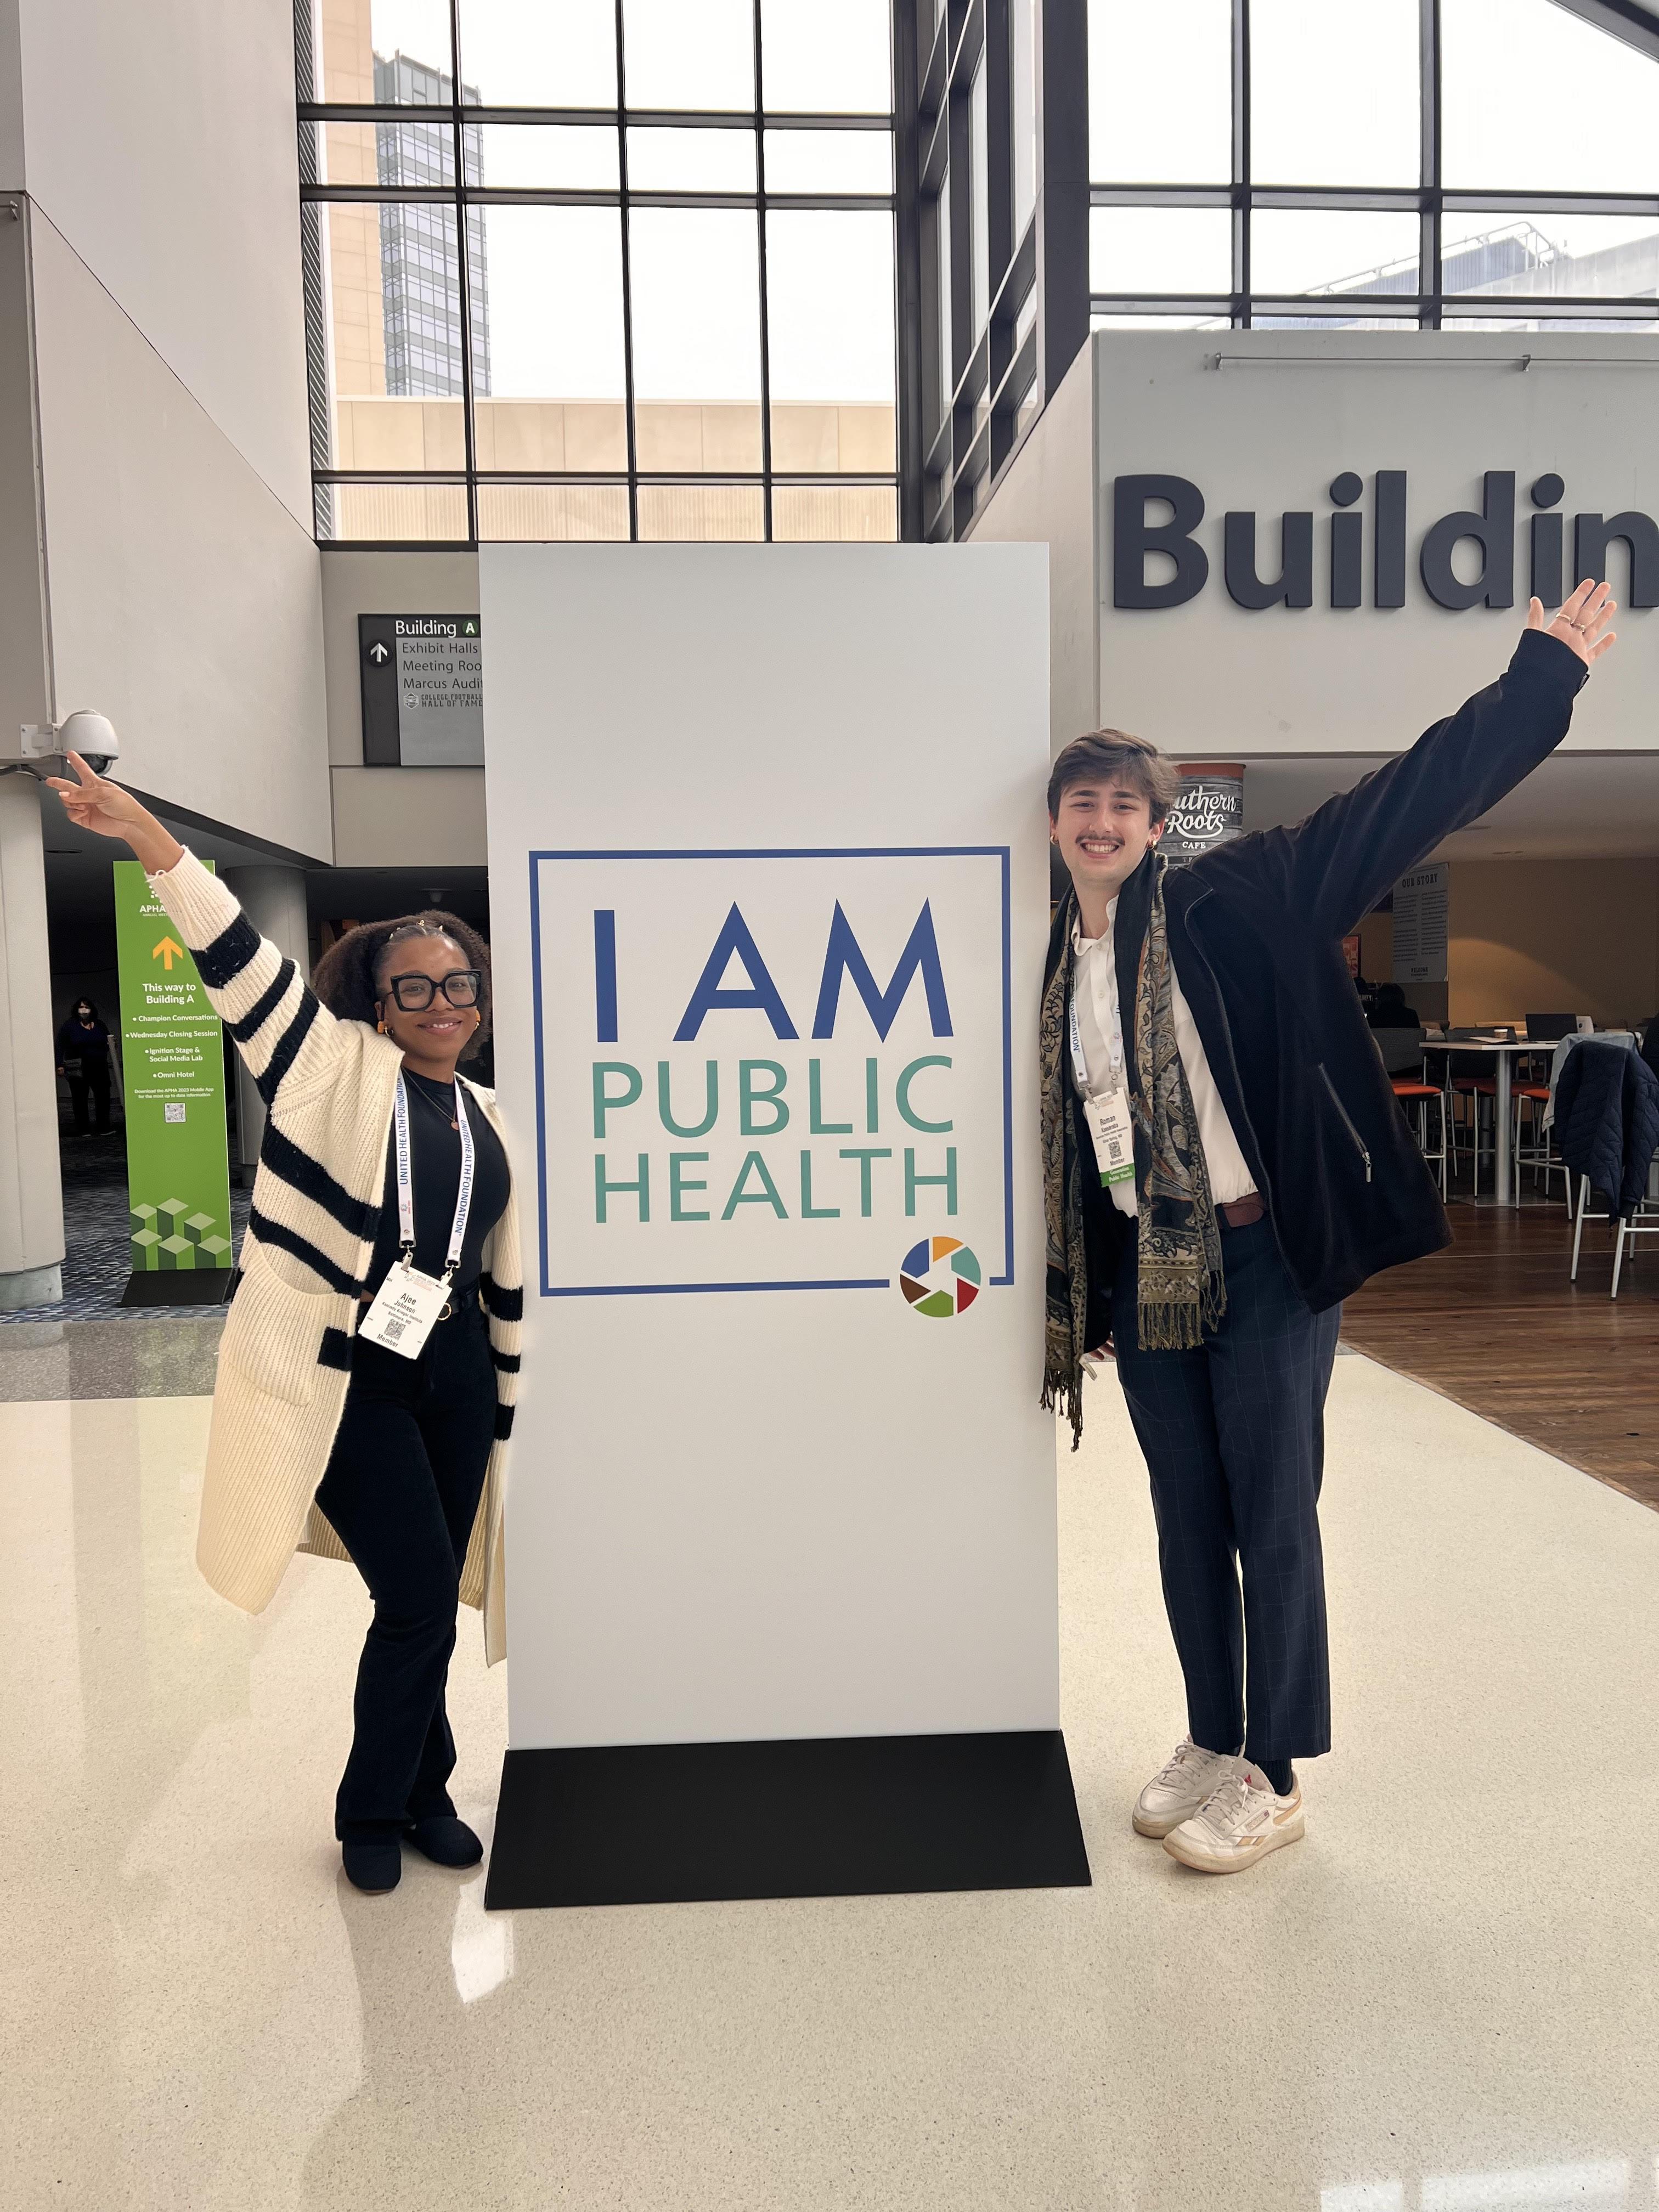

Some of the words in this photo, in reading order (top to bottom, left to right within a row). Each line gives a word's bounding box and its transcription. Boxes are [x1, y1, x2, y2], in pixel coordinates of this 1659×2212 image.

[1114, 470, 1659, 610] Buildin
[396, 620, 456, 638] Building
[466, 622, 475, 634] A
[402, 642, 444, 653] Exhibit
[449, 642, 478, 653] Halls
[403, 660, 453, 673] Meeting
[459, 660, 482, 671] Roo
[404, 678, 447, 689] Marcus
[1165, 810, 1227, 838] Roots
[1182, 841, 1206, 849] CAFE
[1402, 878, 1414, 888] OUR
[1417, 873, 1438, 885] STORY
[594, 910, 618, 1042] I
[673, 896, 953, 1043] AM
[142, 983, 162, 992] This
[165, 984, 184, 992] way
[146, 995, 185, 1005] Building
[187, 994, 194, 1003] A
[592, 1055, 953, 1139] PUBLIC
[398, 1120, 407, 1149] HEALTH
[461, 1120, 471, 1143] UNITED
[399, 1150, 408, 1184] UNITED
[464, 1143, 472, 1175] HEALTH
[595, 1147, 958, 1223] HEALTH
[394, 1300, 416, 1313] Johnson
[376, 1334, 398, 1347] Member
